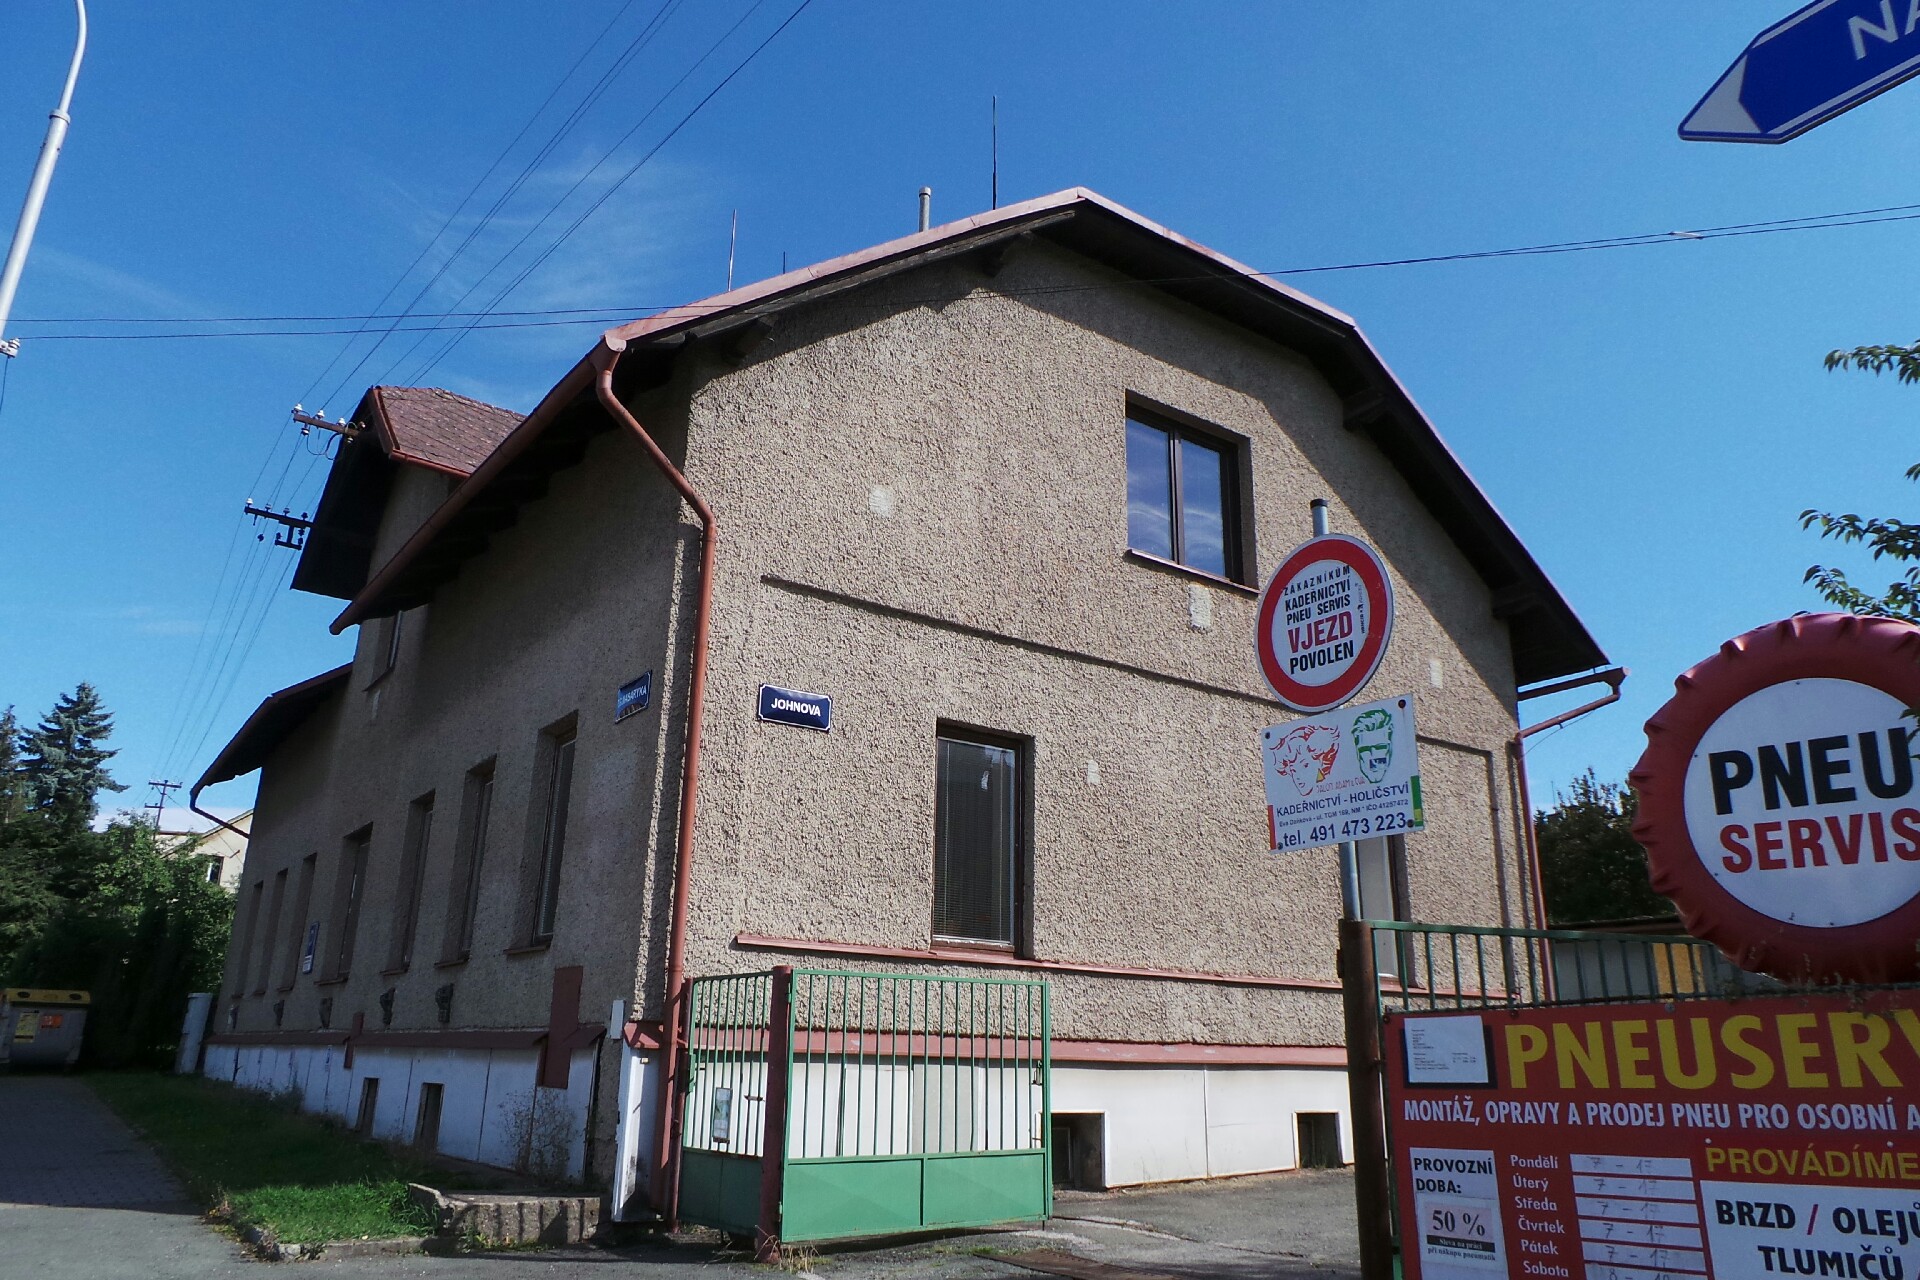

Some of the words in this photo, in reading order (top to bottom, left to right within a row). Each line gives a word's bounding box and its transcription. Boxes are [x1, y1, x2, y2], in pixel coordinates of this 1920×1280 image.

[1285, 576, 1350, 612] KADEŘNICTVÍ
[1287, 607, 1311, 625] PNEU
[1317, 594, 1351, 615] SERVIS
[1287, 611, 1353, 654] VJEZD
[1289, 640, 1354, 675] POVOLEN
[771, 698, 821, 717] JOHNOVA
[1708, 727, 1915, 816] PNEU
[1277, 794, 1341, 818] KADEŘNICTVÍ
[1350, 781, 1409, 803] HOLIČSTVÍ
[1284, 829, 1306, 847] tel.
[1310, 823, 1335, 842] 491
[1342, 818, 1370, 836] 473
[1375, 812, 1406, 831] 223
[1720, 807, 1920, 874] SERVIS
[1404, 1095, 1480, 1126] MONTÁŽ,
[1485, 1101, 1560, 1124] OPRAVY
[1568, 1102, 1582, 1125] A
[1586, 1103, 1664, 1127] PRODEJ
[1672, 1103, 1731, 1128] PNEU
[1738, 1103, 1789, 1129] PRO
[1797, 1097, 1897, 1130] OSOBNÍ
[1413, 1157, 1493, 1174] PROVOZNÍ
[1510, 1154, 1558, 1169] Pondělí
[1705, 1143, 1920, 1180] PROVÁDÍME
[1416, 1178, 1462, 1194] DOBA:
[1513, 1173, 1549, 1192] Úterý
[1515, 1196, 1557, 1211] Středa
[1715, 1200, 1796, 1230] BRZD
[1433, 1209, 1455, 1232] 50
[1462, 1213, 1485, 1236] %
[1518, 1215, 1565, 1234] Čtvrtek
[1520, 1239, 1559, 1256] Pátek
[1757, 1244, 1904, 1280] TLUMIČŮ
[1523, 1261, 1569, 1278] Sobota
